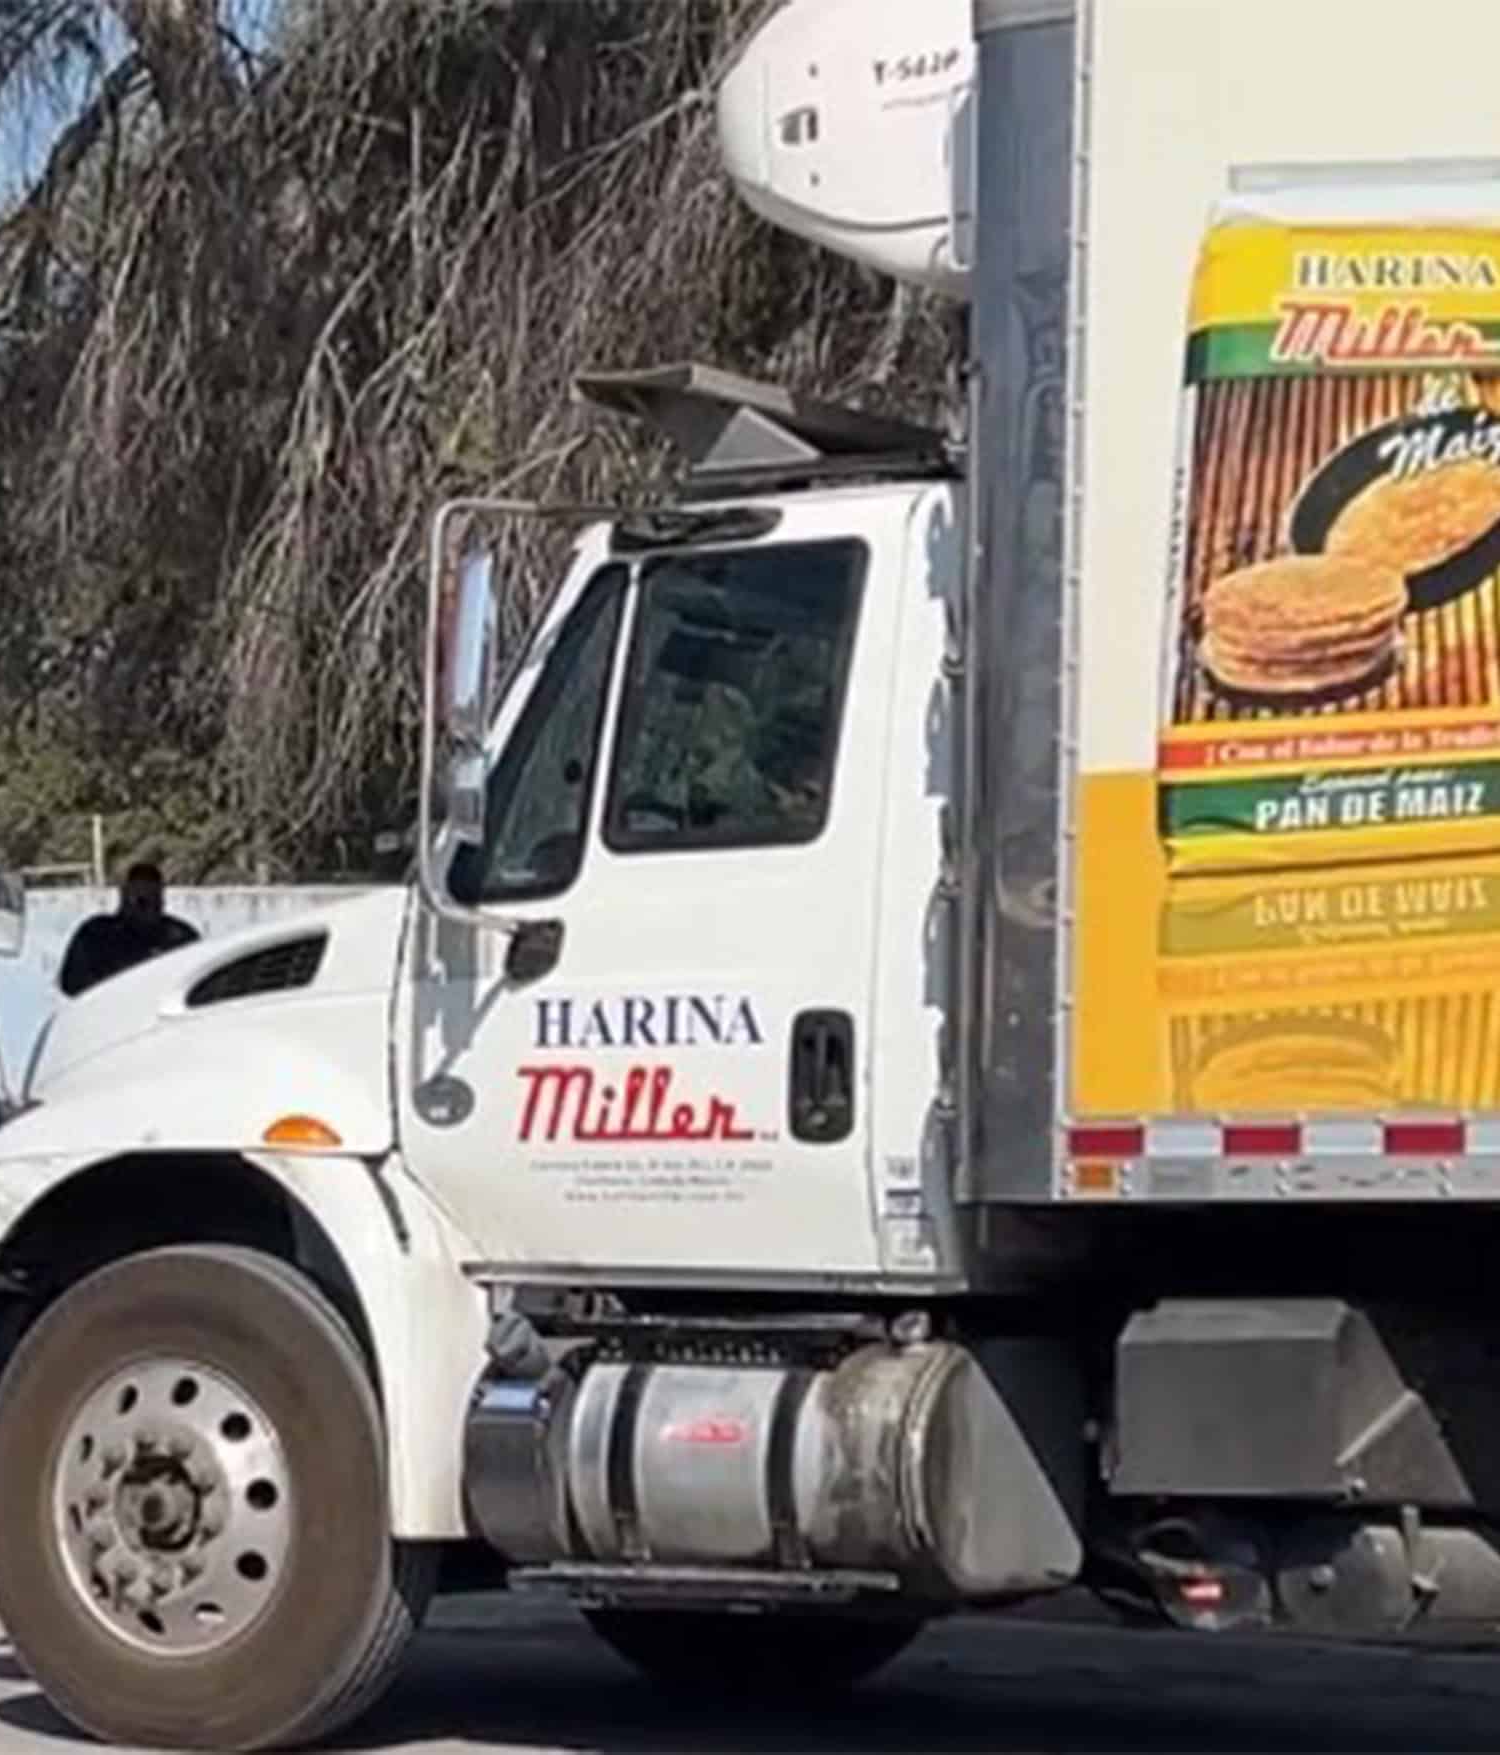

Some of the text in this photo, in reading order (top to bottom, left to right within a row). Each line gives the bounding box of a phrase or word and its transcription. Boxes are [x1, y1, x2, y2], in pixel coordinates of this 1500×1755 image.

[1298, 255, 1497, 286] HARINA
[1275, 301, 1496, 359] Miller
[1255, 781, 1486, 831] PAN DE MAIZ
[534, 995, 765, 1047] HARINA
[516, 1066, 754, 1142] Miller
